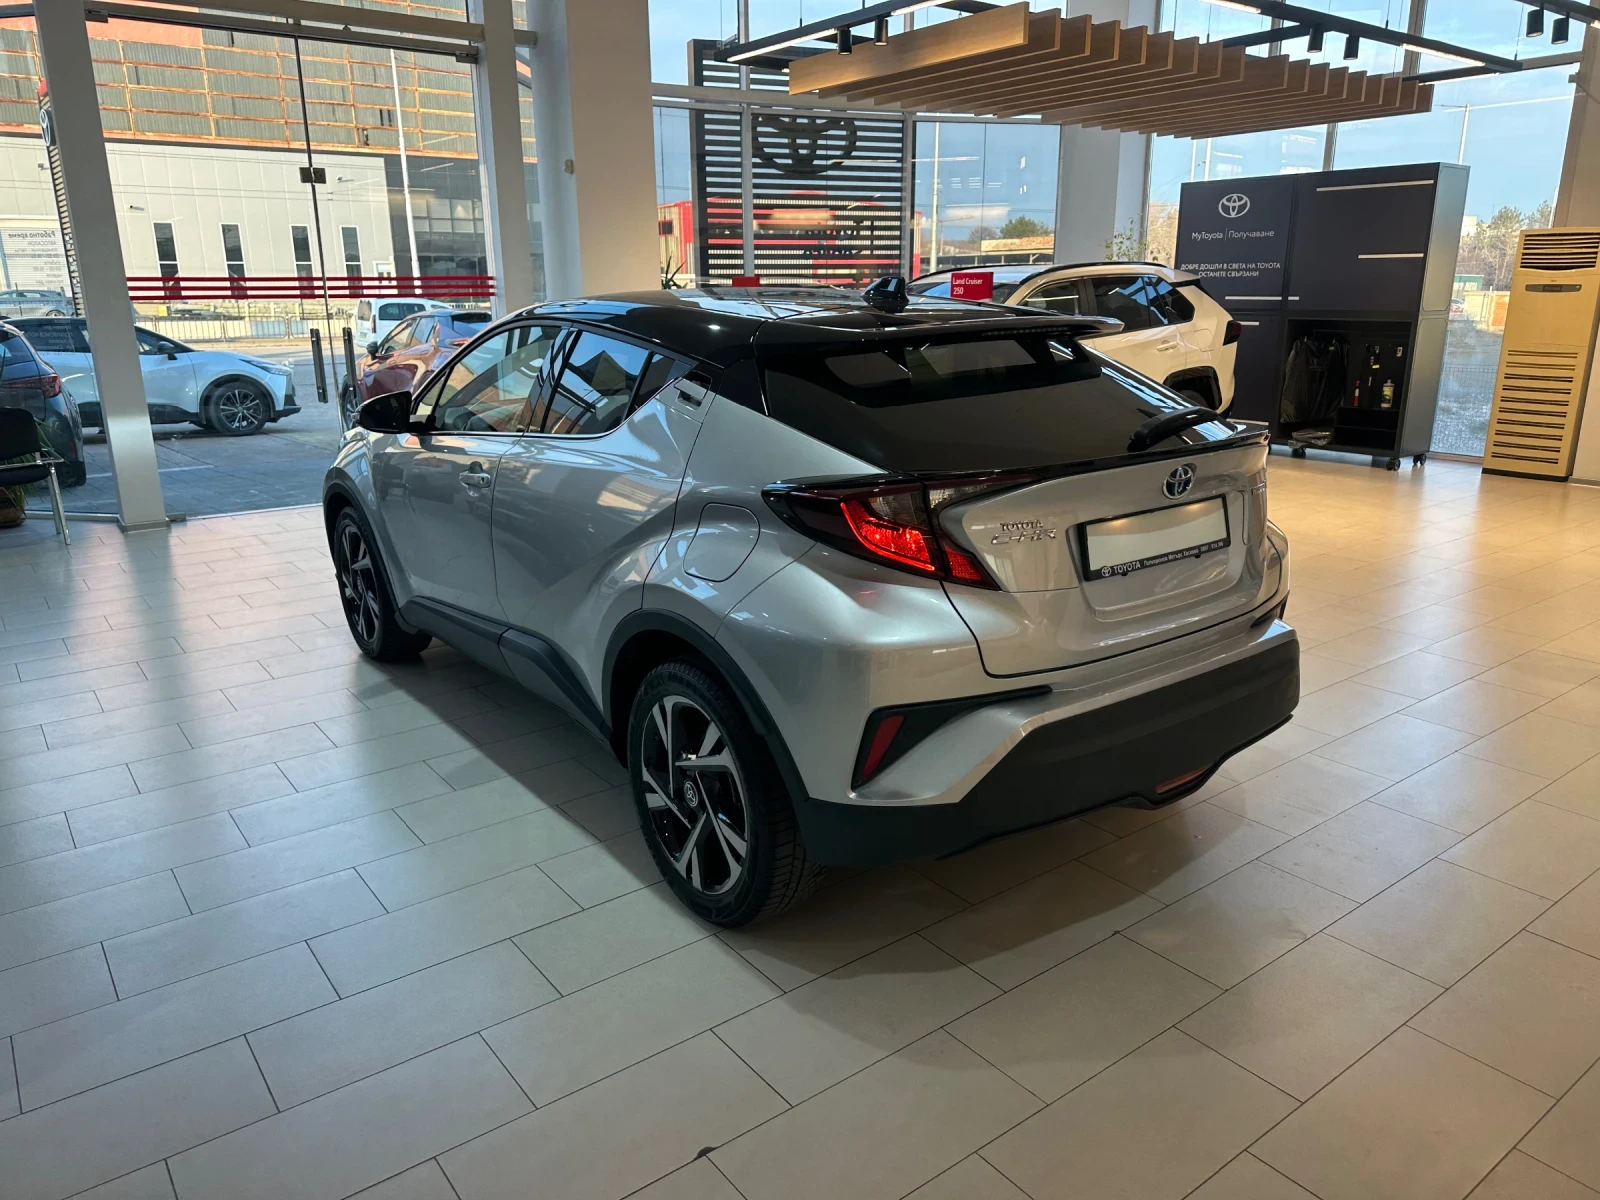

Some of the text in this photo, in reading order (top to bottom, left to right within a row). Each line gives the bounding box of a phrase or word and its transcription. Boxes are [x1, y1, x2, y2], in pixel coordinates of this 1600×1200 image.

[1191, 230, 1275, 241] MyToyota Получаване
[1180, 263, 1199, 271] ДОБРЕ
[1228, 262, 1246, 270] СВЕТА
[1227, 270, 1259, 278] СВЪРЗАНИ
[952, 277, 983, 285] Land Cruiser
[953, 286, 964, 295] 250
[999, 519, 1044, 532] TOYOTA
[990, 528, 1057, 545] C-HR
[1113, 561, 1141, 574] TOYOTA
